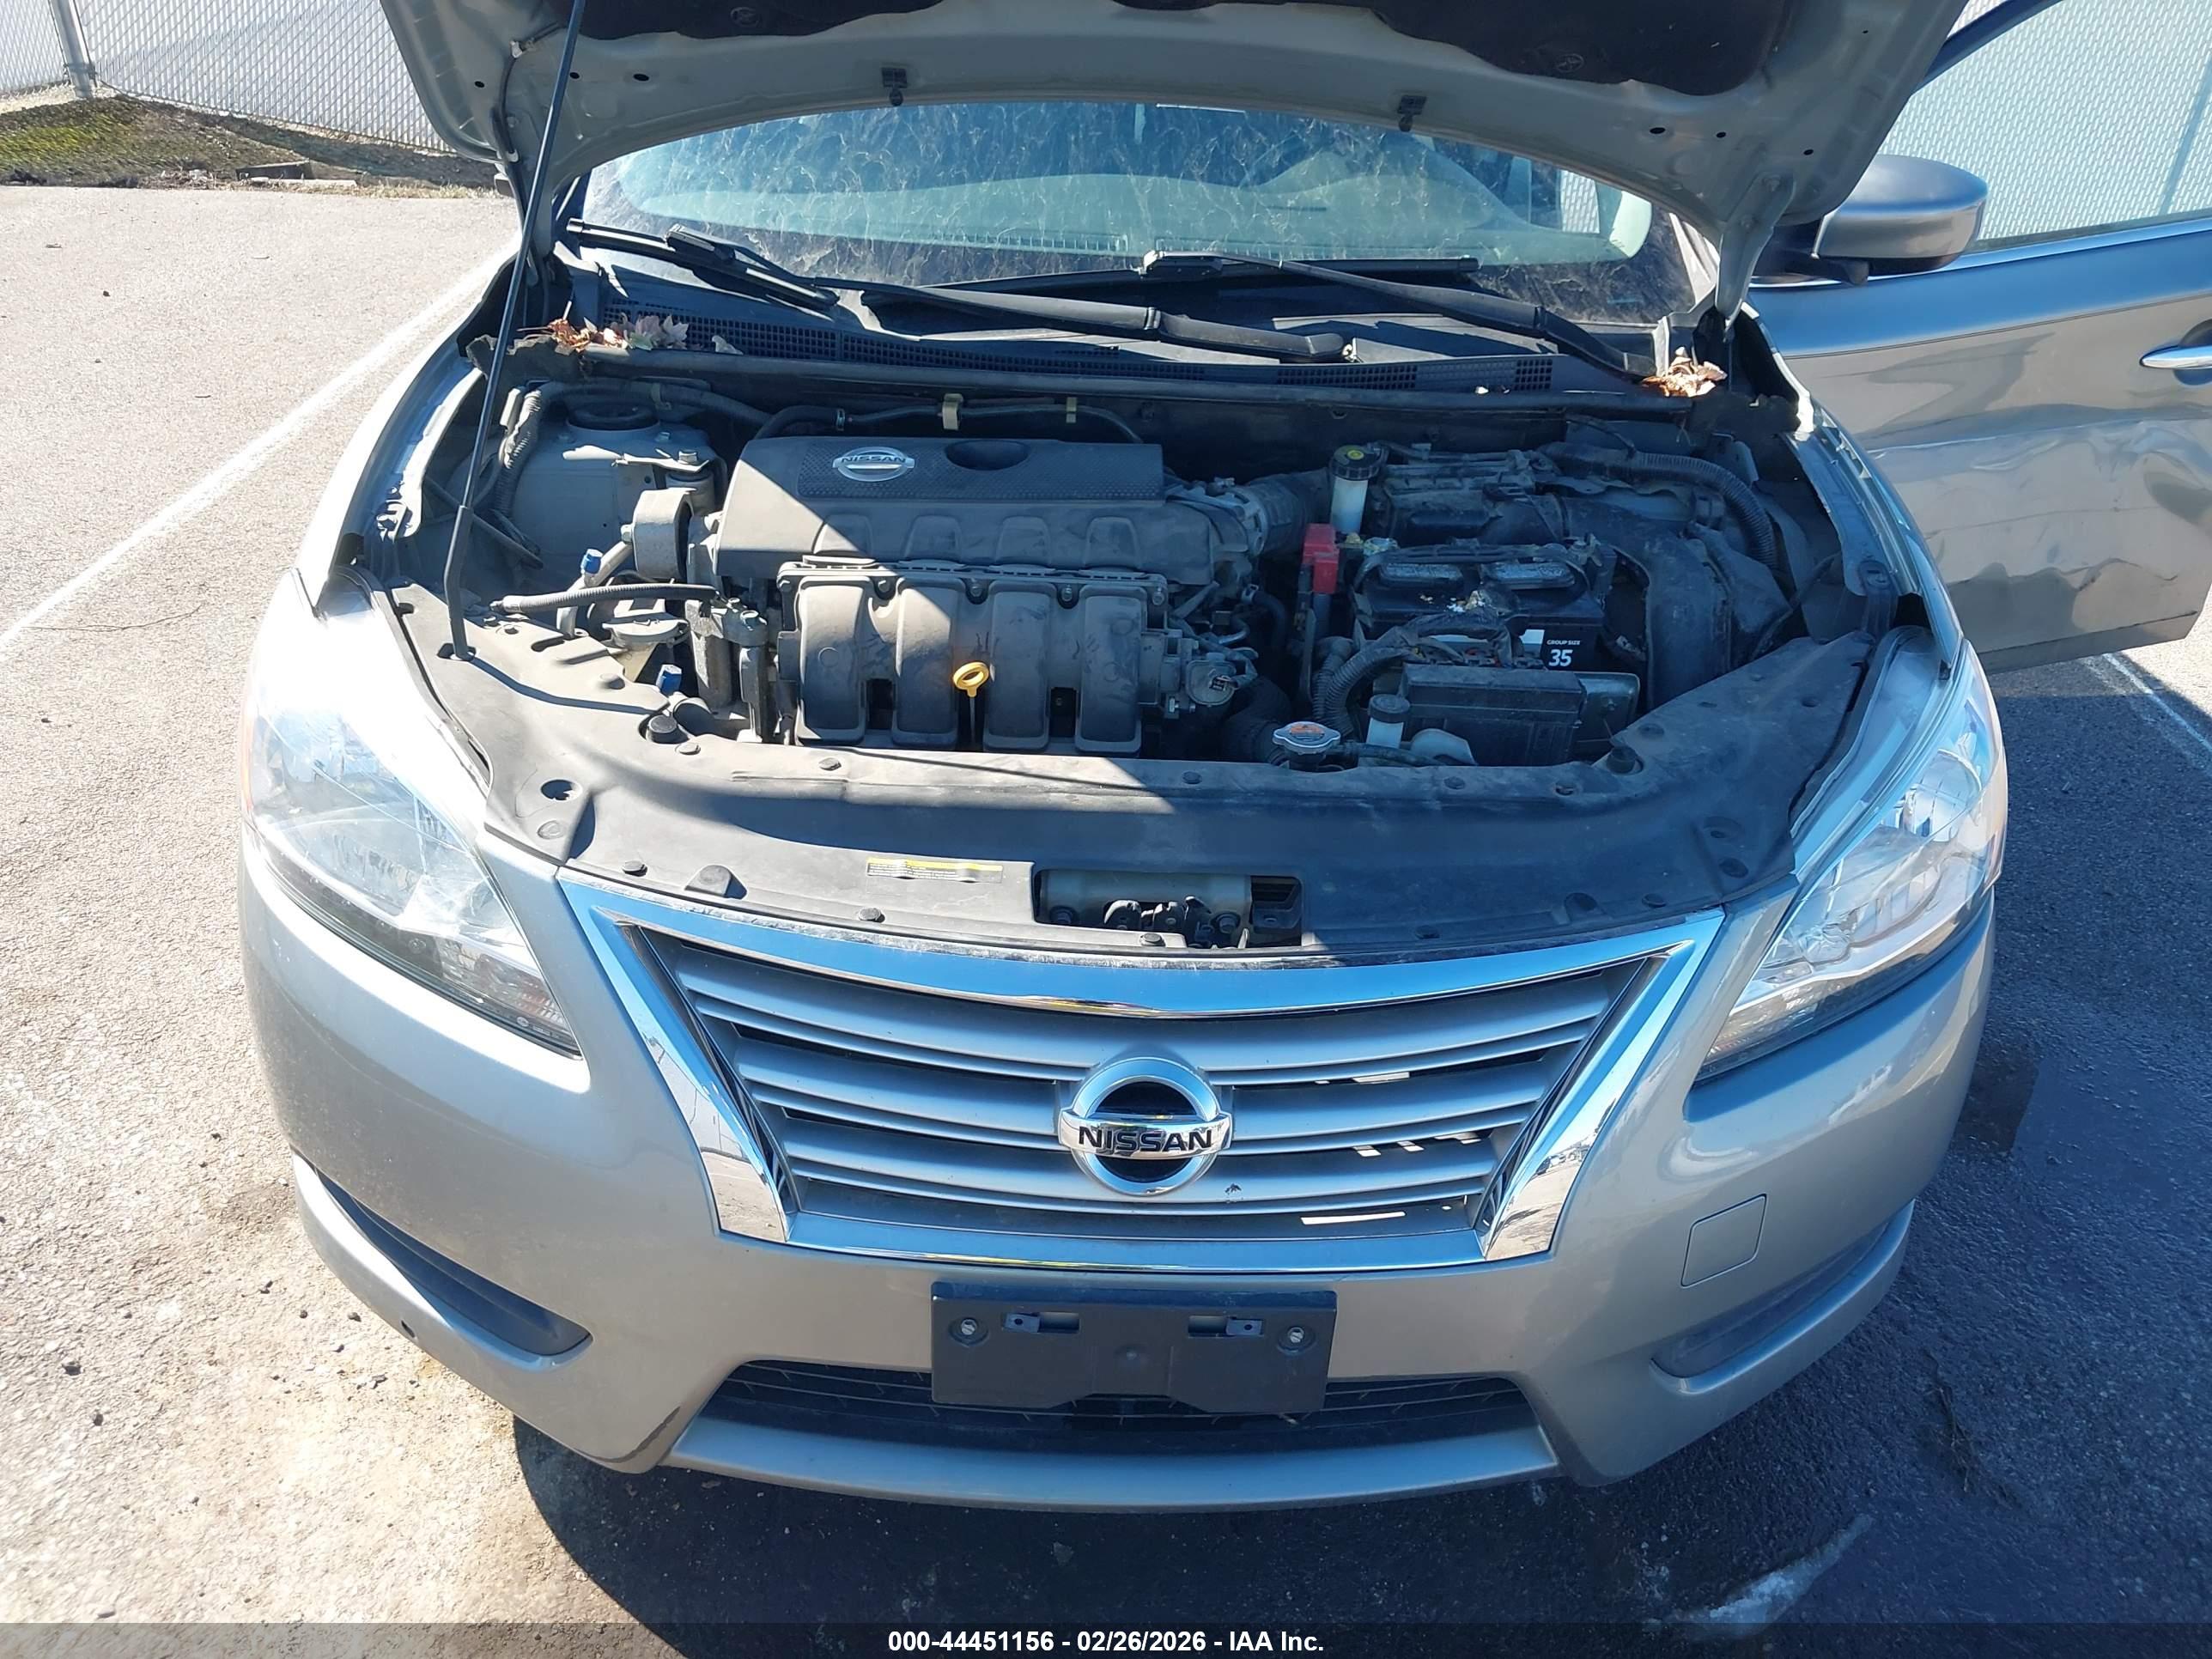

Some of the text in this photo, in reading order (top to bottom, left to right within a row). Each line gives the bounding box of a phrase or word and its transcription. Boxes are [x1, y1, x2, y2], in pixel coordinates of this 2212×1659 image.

[842, 455, 906, 464] NISSAN
[1548, 648, 1573, 666] 35
[1079, 1126, 1212, 1152] NISSAN
